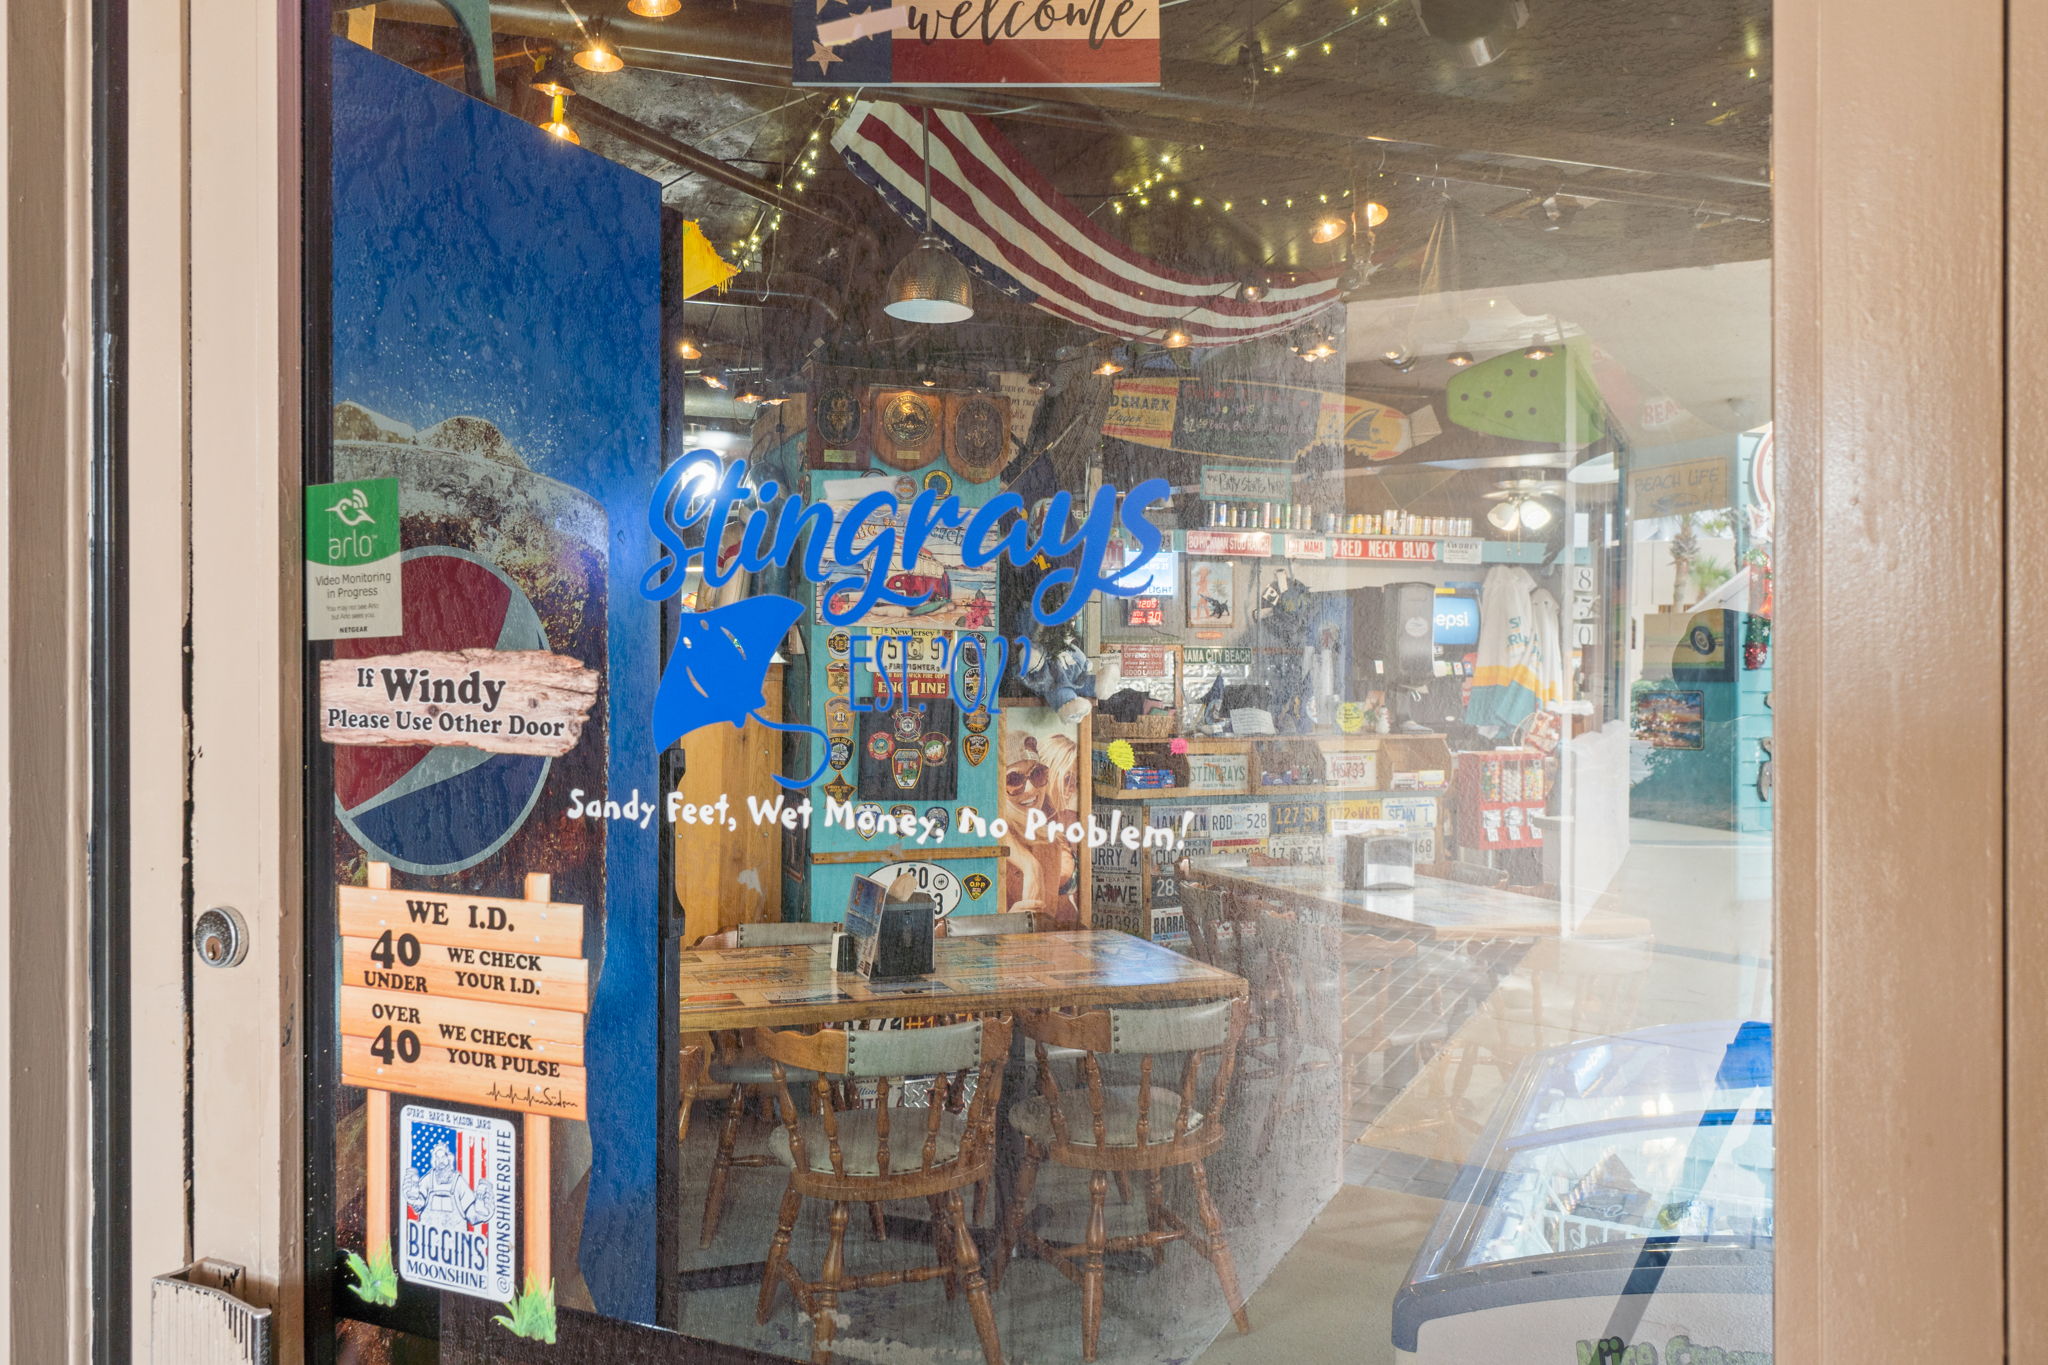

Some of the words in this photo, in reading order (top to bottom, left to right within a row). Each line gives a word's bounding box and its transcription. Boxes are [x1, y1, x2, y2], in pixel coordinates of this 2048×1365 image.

[907, 0, 1147, 49] welcome
[1634, 471, 1681, 493] BEACH
[639, 449, 1171, 626] Stingrays
[1229, 537, 1246, 551] STUD
[1341, 540, 1362, 557] RED
[1368, 540, 1397, 558] NECK
[1402, 541, 1430, 559] BLVD
[315, 575, 340, 586] Video
[342, 572, 391, 584] Monitoring
[1578, 569, 1591, 589] 8
[327, 589, 336, 599] in
[338, 587, 378, 600] Progress
[339, 625, 368, 633] NETGEAR
[890, 628, 909, 636] New
[910, 628, 935, 637] Jersey
[1206, 649, 1223, 663] CITY
[1225, 649, 1250, 663] BEACH
[849, 634, 927, 713] EST.
[357, 667, 374, 688] If
[381, 667, 506, 713] Windy
[328, 708, 390, 729] Please
[395, 710, 433, 731] Use
[438, 712, 503, 735] Other
[508, 714, 565, 736] Door
[566, 788, 656, 829] Sandy
[667, 791, 737, 832] Feet,
[747, 793, 813, 830] Wet
[824, 795, 945, 845] Money,
[1024, 807, 1196, 850] Problem!
[1247, 813, 1267, 829] 528
[1275, 807, 1299, 825] 127
[405, 898, 450, 928] WE
[467, 904, 515, 932] I.D.
[370, 929, 421, 969] 40
[447, 947, 476, 965] WE
[478, 950, 542, 973] CHECK
[363, 969, 428, 994] UNDER
[454, 970, 506, 993] YOUR
[509, 975, 541, 996] I.D.
[371, 1003, 421, 1025] OVER
[370, 1024, 421, 1066] 40
[438, 1023, 468, 1042] WE
[470, 1026, 533, 1051] CHECK
[445, 1047, 497, 1070] YOUR
[501, 1054, 560, 1079] PULSE
[406, 1107, 425, 1118] STARS
[428, 1110, 445, 1122] BARS
[453, 1115, 474, 1127] MASON
[476, 1118, 492, 1130] JARS
[496, 1130, 512, 1294] @MOONSHINERSLIFE
[408, 1221, 486, 1272] BIGGINS
[406, 1260, 487, 1290] MOONSHINE
